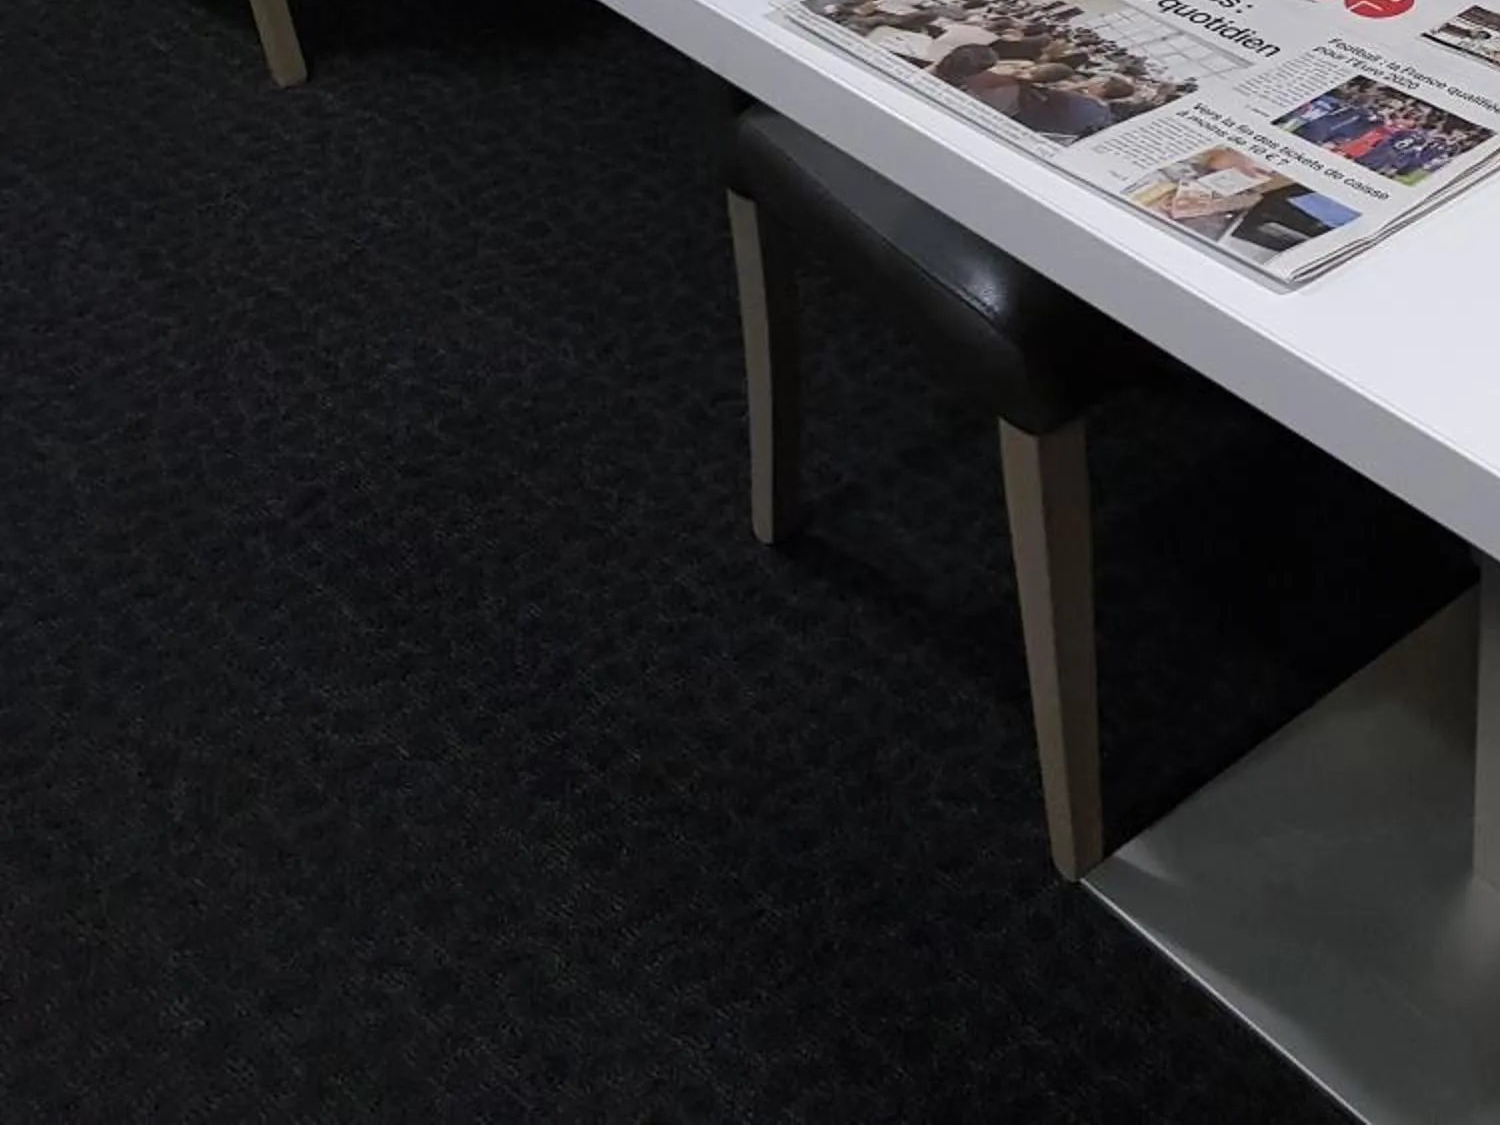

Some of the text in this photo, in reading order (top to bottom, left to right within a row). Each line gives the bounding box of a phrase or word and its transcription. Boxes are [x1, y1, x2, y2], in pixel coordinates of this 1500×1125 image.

[1383, 72, 1420, 90] 2020
[1400, 64, 1447, 88] France
[1188, 115, 1228, 138] moins
[1227, 135, 1247, 147] de
[1193, 102, 1390, 201] Vers la fin des tickets de caisse
